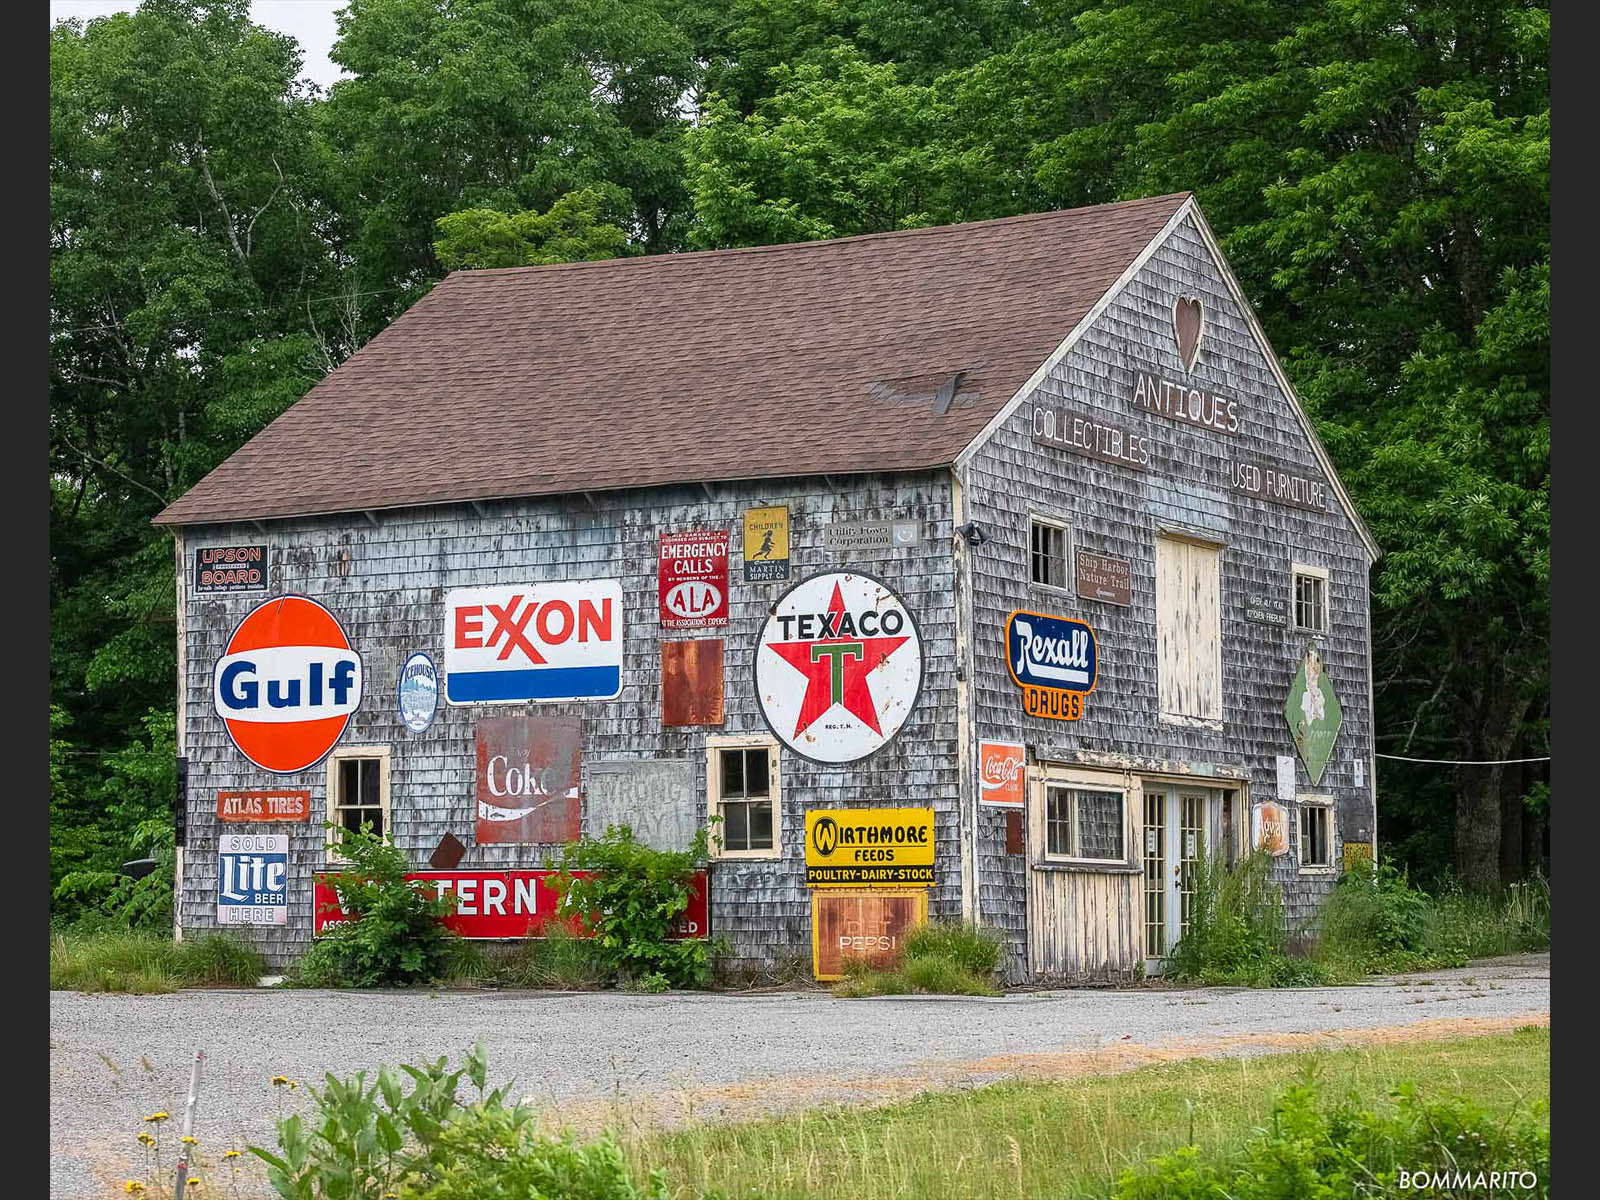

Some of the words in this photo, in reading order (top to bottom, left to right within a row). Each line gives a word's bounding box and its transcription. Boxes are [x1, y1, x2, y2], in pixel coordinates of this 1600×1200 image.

[1133, 373, 1239, 432] ANTIQUES
[1033, 407, 1148, 465] COLLECTIBLES
[1231, 461, 1261, 493] USED
[1266, 470, 1326, 508] FURNITURE
[749, 522, 784, 531] CHILDREN
[661, 542, 728, 560] EMERGENCY
[829, 536, 889, 548] Corporation
[202, 547, 261, 564] UPSON
[673, 558, 713, 575] CALLS
[1080, 553, 1098, 571] Ship
[1101, 559, 1128, 576] Harbor
[201, 569, 261, 585] BOARD
[749, 564, 785, 573] MARTIN
[749, 572, 773, 580] SUPPLY
[1080, 567, 1108, 585] Nature
[1111, 575, 1130, 590] Trail
[672, 586, 715, 612] ALA
[454, 594, 612, 665] EXXON
[776, 609, 904, 641] TEXACO
[1015, 619, 1088, 684] Rexall
[219, 660, 356, 710] Gulf
[403, 663, 435, 685] ICEHOUSE
[811, 642, 864, 707] T
[1029, 688, 1080, 718] DRUGS
[223, 797, 263, 815] ATLAS
[266, 797, 304, 814] TIRES
[230, 836, 277, 851] SOLD
[813, 816, 928, 857] WIRTHMORE
[854, 849, 895, 862] FEEDS
[219, 855, 286, 903] Lite
[254, 893, 284, 905] BEER
[335, 878, 537, 916] TERN
[229, 908, 275, 921] HERE
[839, 935, 896, 951] PEPSI
